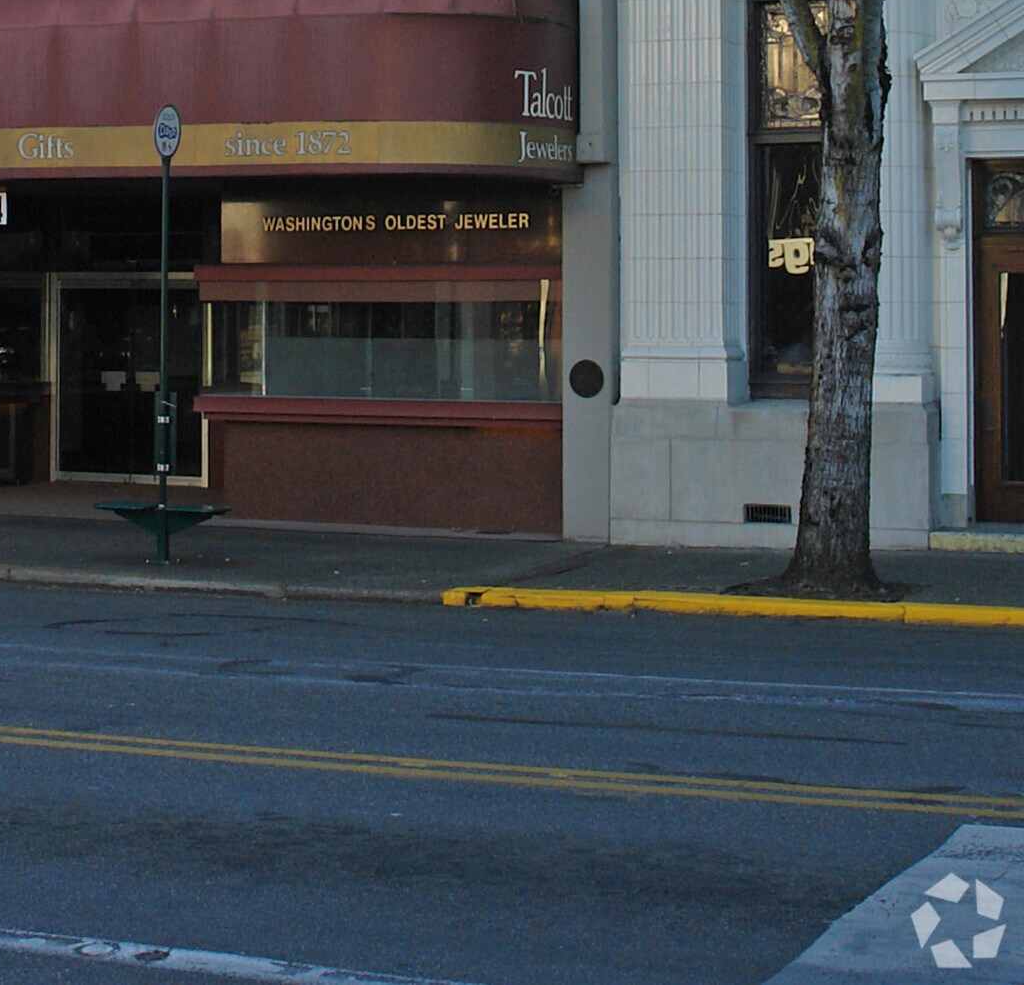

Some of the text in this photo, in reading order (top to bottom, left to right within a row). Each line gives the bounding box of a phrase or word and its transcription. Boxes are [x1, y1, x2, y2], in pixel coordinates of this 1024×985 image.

[514, 67, 573, 121] Talcott
[17, 133, 74, 160] Gifts
[226, 130, 352, 157] since 1872
[518, 131, 573, 162] Jewelers
[384, 214, 446, 231] OLDEST
[454, 213, 530, 230] JEWELER
